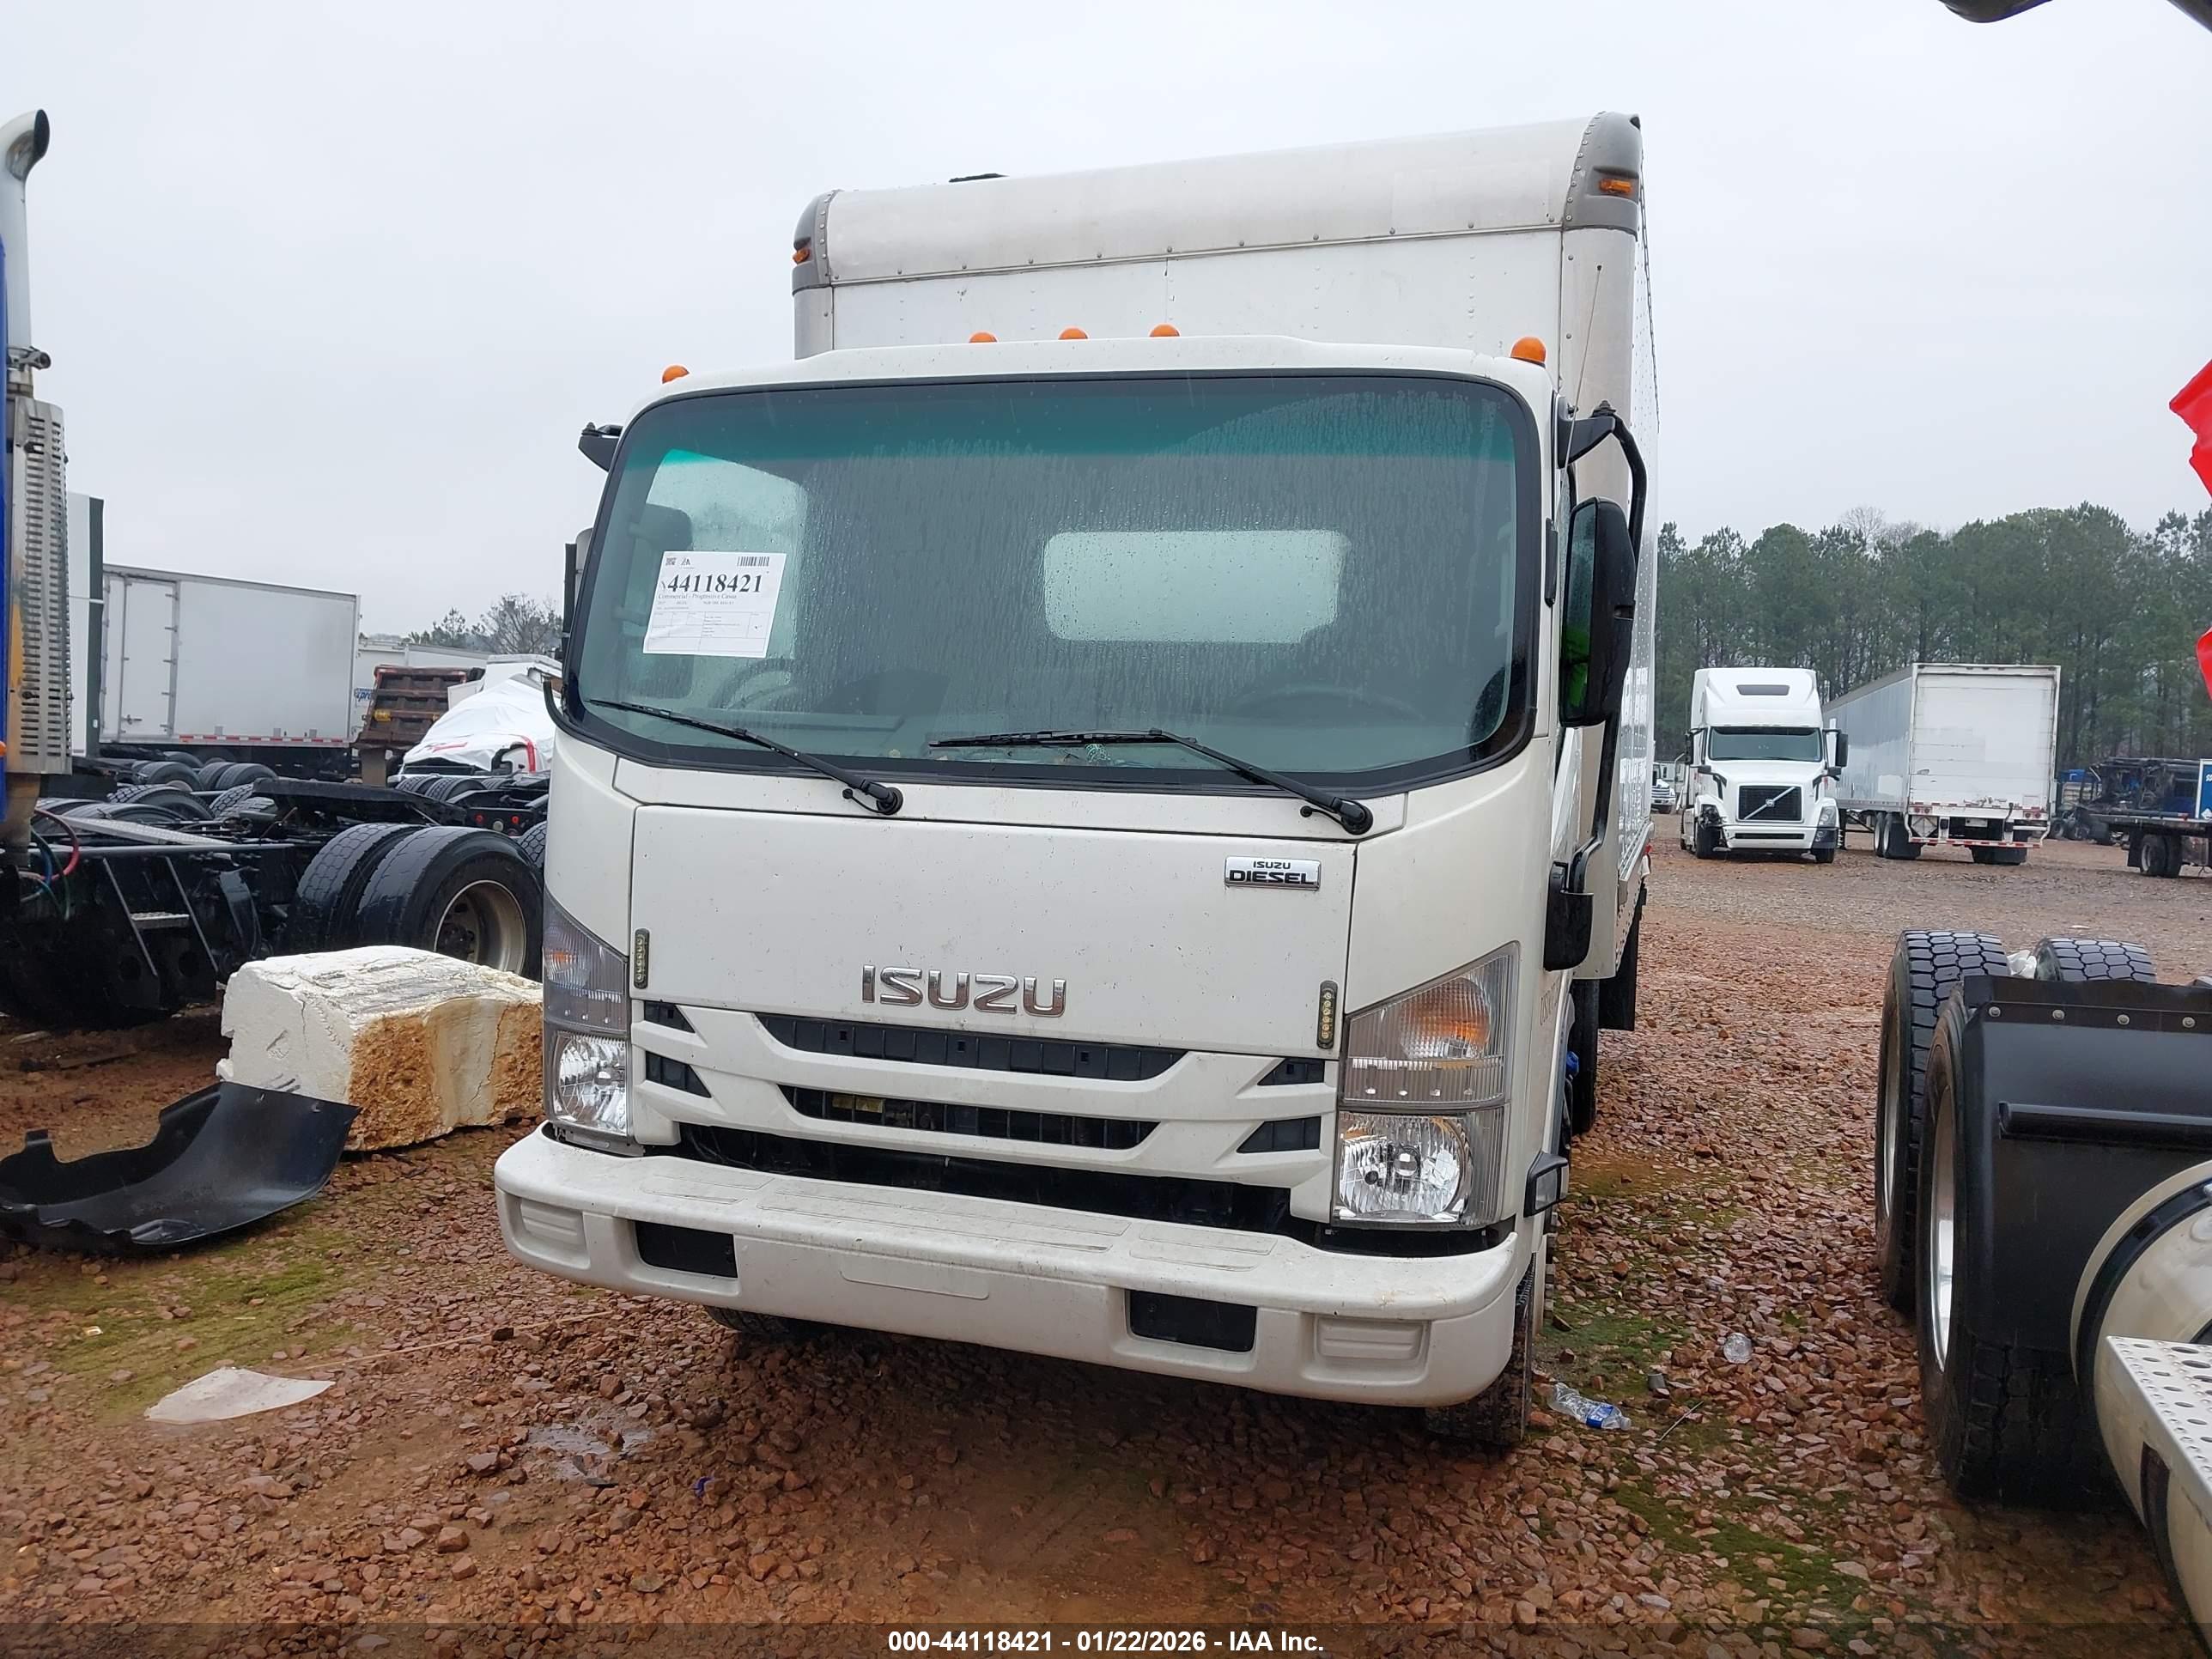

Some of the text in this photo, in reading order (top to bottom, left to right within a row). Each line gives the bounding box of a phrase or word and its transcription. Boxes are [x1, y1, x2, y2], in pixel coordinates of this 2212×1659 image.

[667, 574, 763, 592] 44118421
[1253, 860, 1291, 870] ISUZU
[1229, 869, 1315, 885] DIESEL
[861, 963, 1067, 1018] ISUZU
